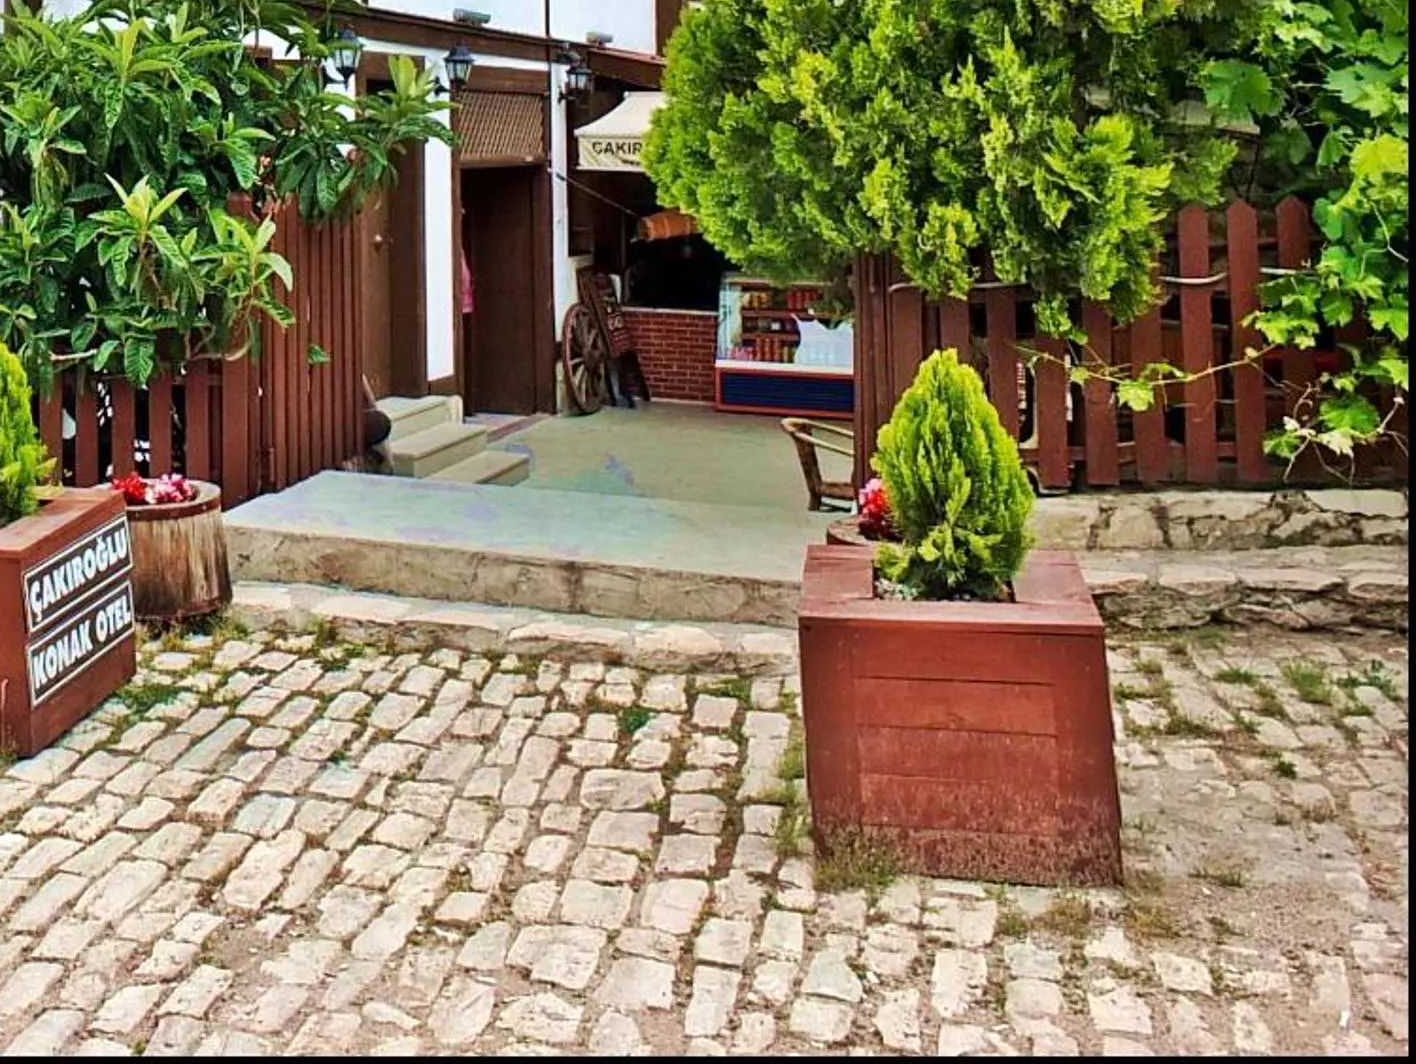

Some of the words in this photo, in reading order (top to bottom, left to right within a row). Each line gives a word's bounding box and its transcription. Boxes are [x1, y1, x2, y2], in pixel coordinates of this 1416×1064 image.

[29, 529, 127, 621] ÇAKIROĞLU
[34, 620, 93, 688] KONAK
[95, 595, 131, 642] OTEL
